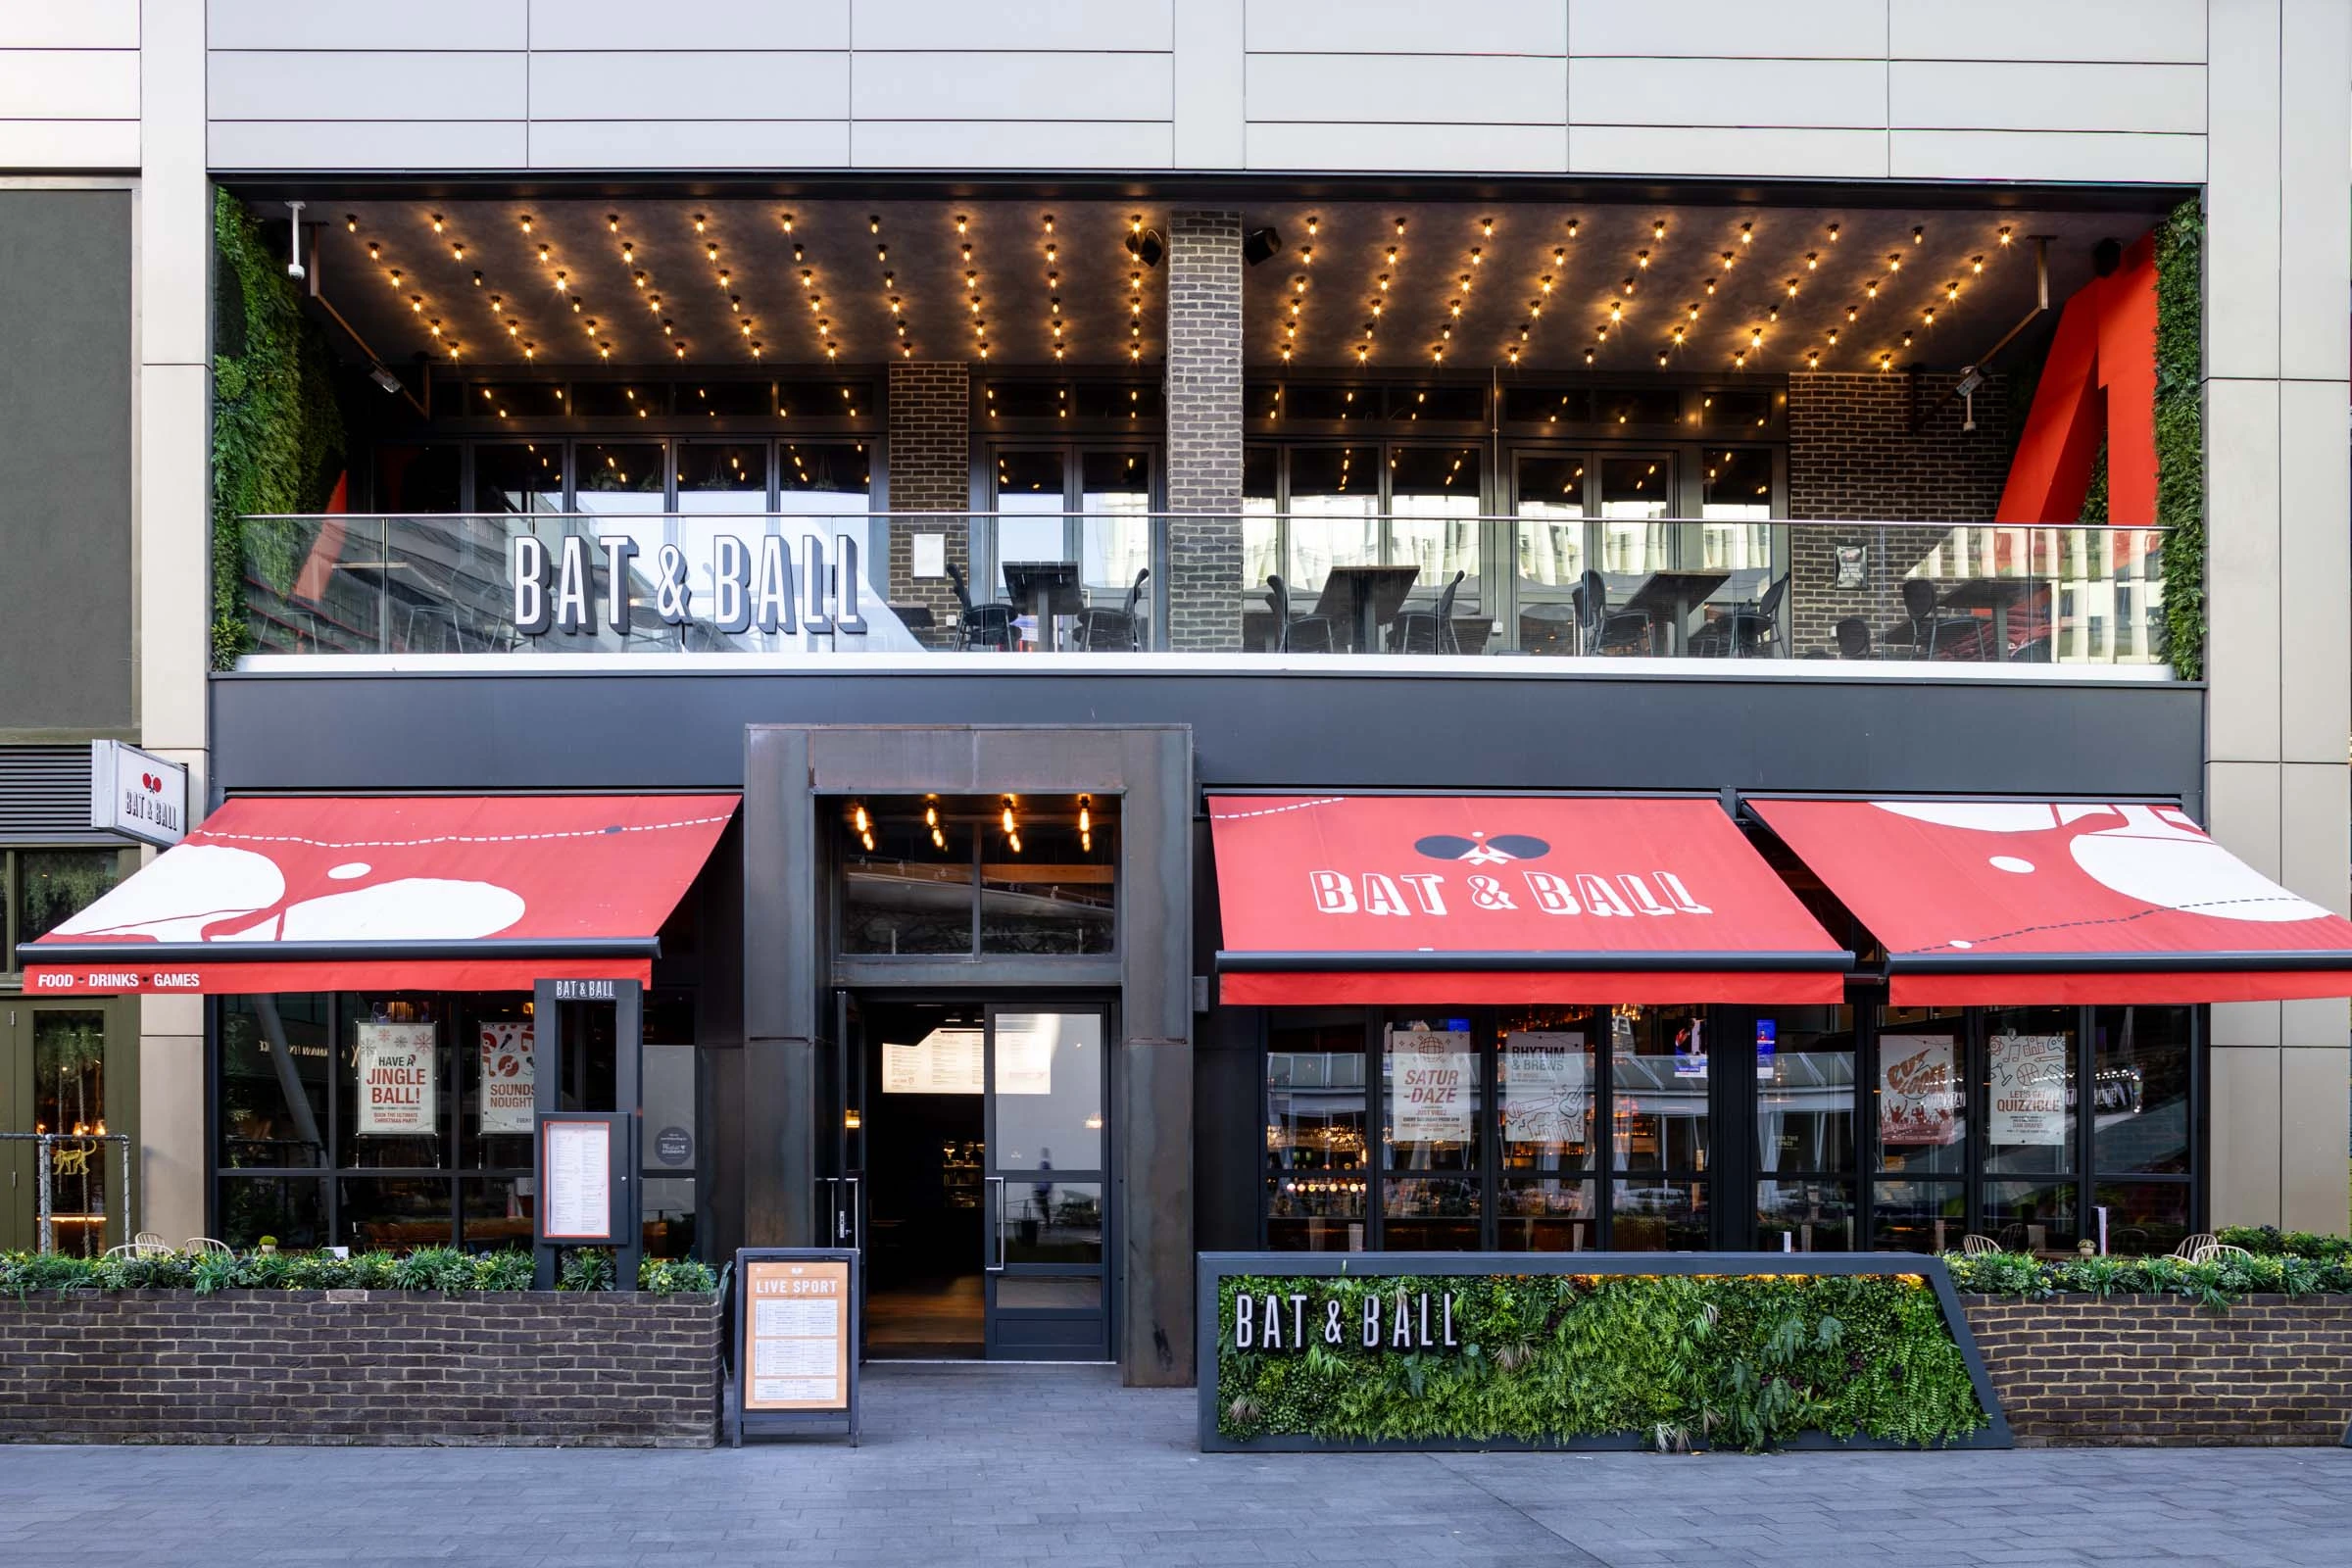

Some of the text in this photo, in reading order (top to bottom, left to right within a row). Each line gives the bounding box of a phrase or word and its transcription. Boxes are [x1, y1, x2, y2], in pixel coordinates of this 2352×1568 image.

[514, 535, 866, 635] BAT & BALL
[125, 791, 177, 831] BAT & BALL
[1310, 870, 1713, 916] BAT & BALL
[38, 973, 200, 987] FOOD DRINKS GAMES
[556, 980, 615, 998] BAT & BALL
[1512, 1046, 1565, 1058] RHYTHM
[378, 1056, 414, 1066] HAVE A
[1512, 1060, 1564, 1071] & BREWS
[367, 1068, 425, 1085] JINGLE
[1404, 1069, 1459, 1085] SATUR
[371, 1087, 420, 1103] BALL!
[1403, 1087, 1457, 1103] -DAZE
[2010, 1090, 2031, 1099] LET'S
[1997, 1099, 2060, 1112] QUIZZICLE
[756, 1279, 838, 1293] LIVE SPORT
[1236, 1293, 1458, 1348] BAT & BALL
